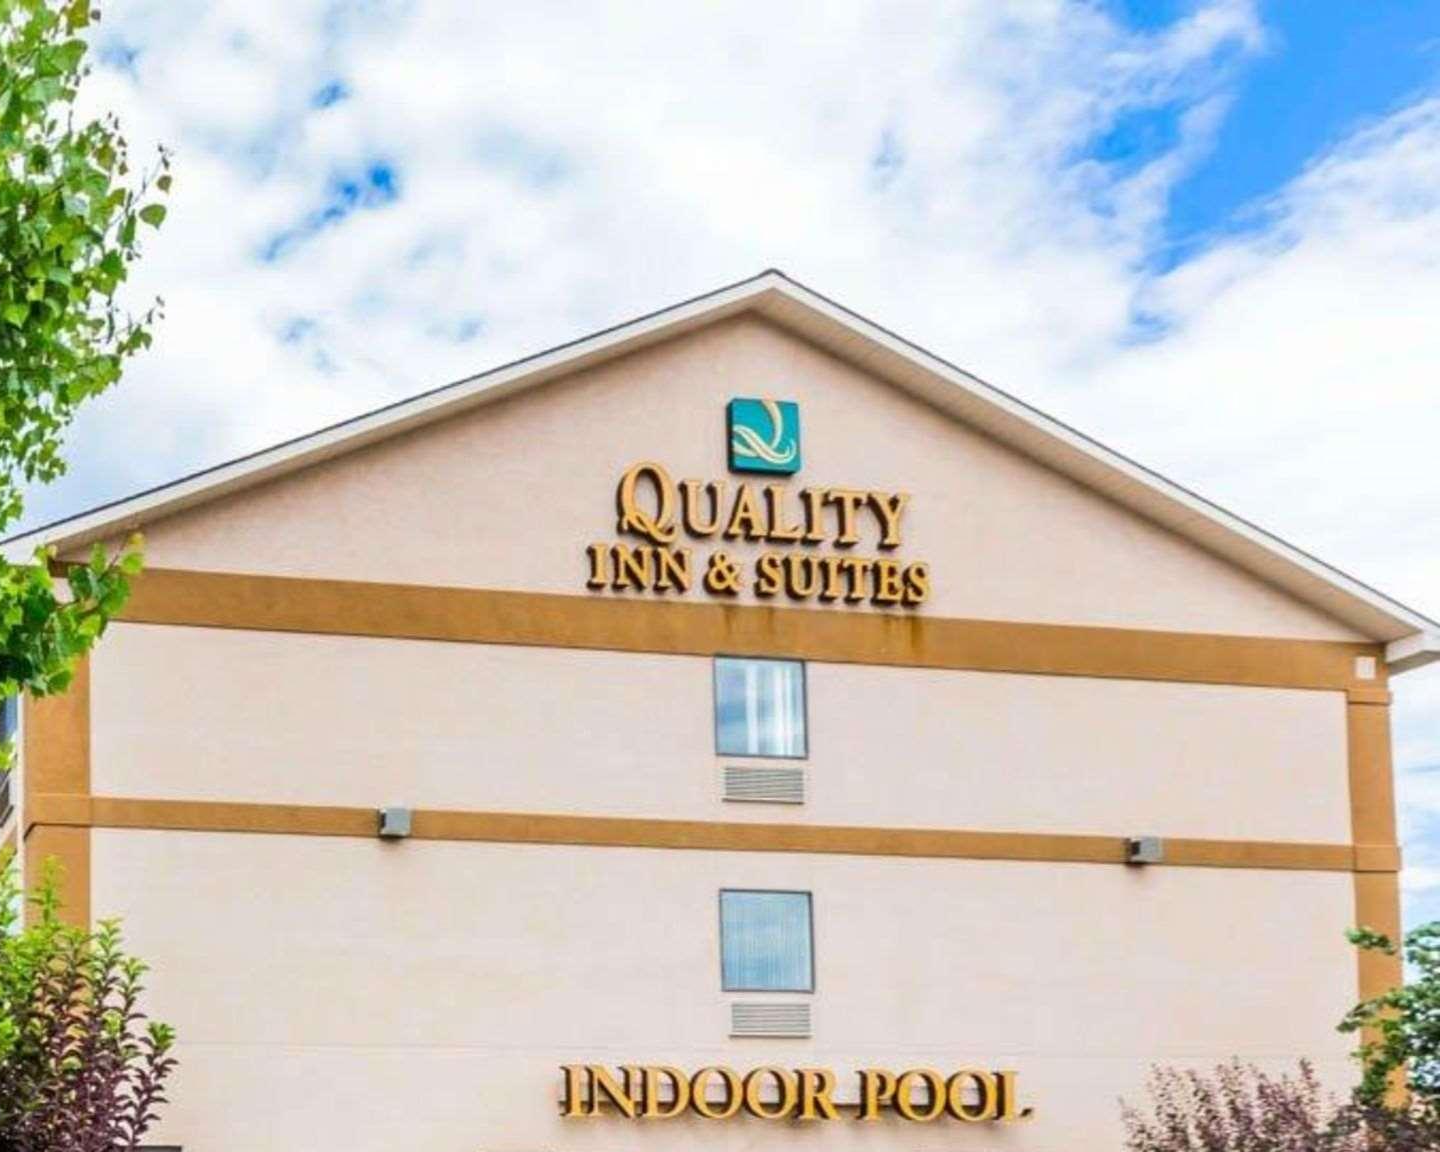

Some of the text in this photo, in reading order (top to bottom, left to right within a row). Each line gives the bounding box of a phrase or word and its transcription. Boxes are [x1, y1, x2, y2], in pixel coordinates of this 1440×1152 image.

[618, 461, 910, 550] QUALITY
[586, 542, 932, 608] INN & SUITES
[560, 1064, 1035, 1125] INDOOR POOL
